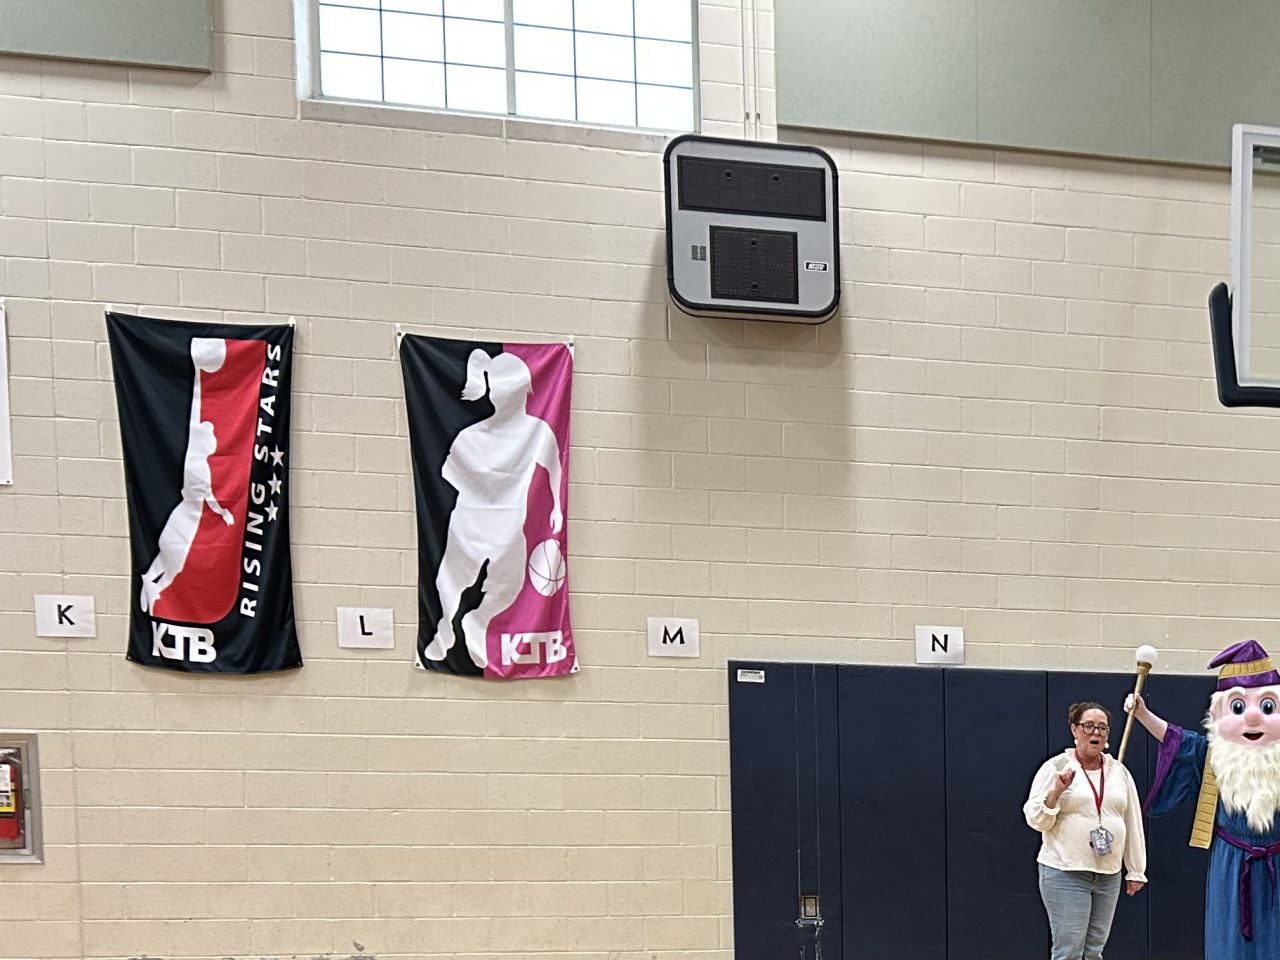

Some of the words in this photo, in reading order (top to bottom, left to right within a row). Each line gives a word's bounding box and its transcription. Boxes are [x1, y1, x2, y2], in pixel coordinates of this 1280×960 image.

[240, 482, 266, 618] RISING
[254, 343, 282, 463] STARS
[57, 604, 76, 626] K
[359, 615, 373, 636] L
[662, 625, 685, 645] M
[931, 633, 949, 653] N
